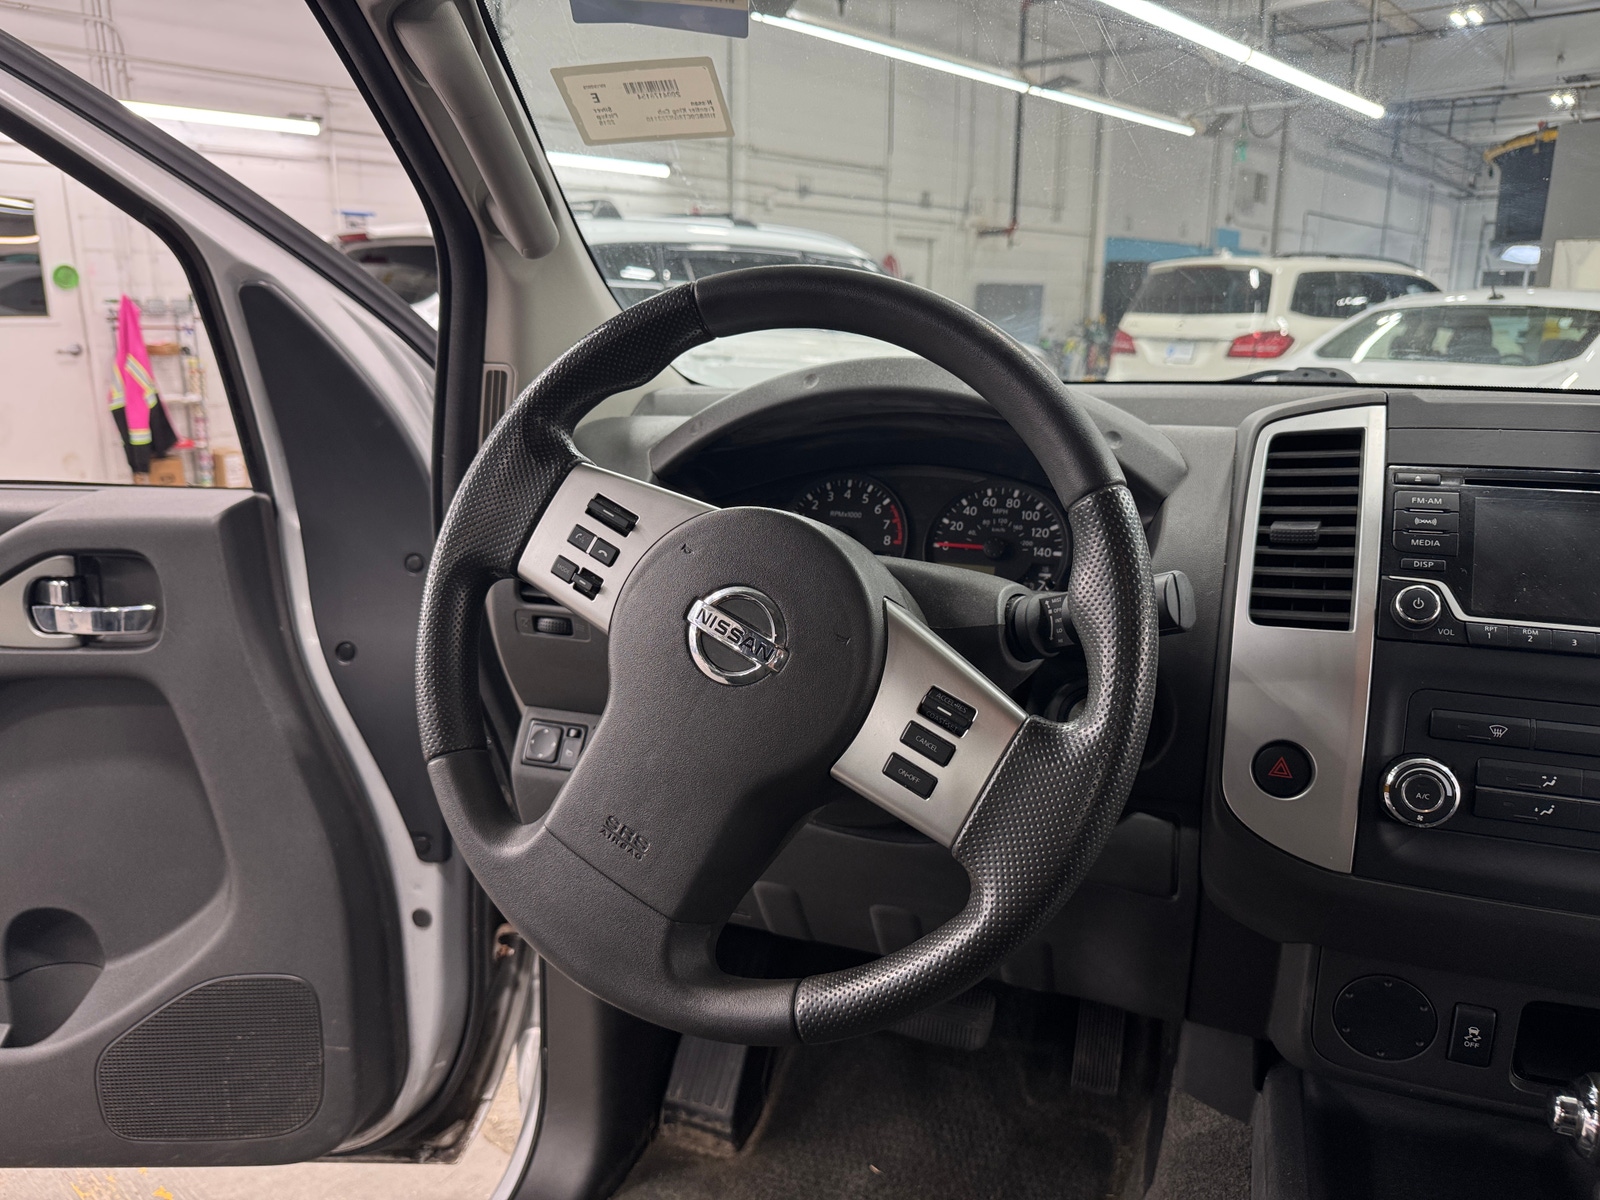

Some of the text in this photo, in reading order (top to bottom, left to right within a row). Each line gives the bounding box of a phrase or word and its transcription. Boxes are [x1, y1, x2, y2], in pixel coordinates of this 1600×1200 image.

[828, 492, 835, 501] 3
[843, 490, 851, 499] 4
[862, 494, 870, 504] 5
[811, 500, 819, 510] 2
[982, 498, 998, 508] 60
[1005, 499, 1021, 509] 80
[874, 505, 882, 514] 6
[963, 506, 978, 516] 40
[1021, 511, 1040, 521] 100
[883, 520, 891, 530] 7
[949, 521, 964, 531] 20
[1031, 527, 1050, 538] 120
[883, 535, 891, 546] 8
[1411, 539, 1441, 547] MEDIA
[1033, 547, 1052, 558] 140
[1413, 560, 1435, 568] DISP
[1437, 627, 1455, 636] VOL
[1484, 625, 1498, 633] RPT
[1522, 628, 1539, 636] RDM
[696, 607, 775, 663] NISSAN
[1527, 635, 1533, 643] 2
[1571, 639, 1578, 647] 3
[915, 734, 938, 753] CANCEL
[1415, 792, 1430, 801] A/C
[604, 815, 651, 853] SRS
[599, 829, 644, 861] AIRBAG
[1463, 1040, 1480, 1049] OFF
